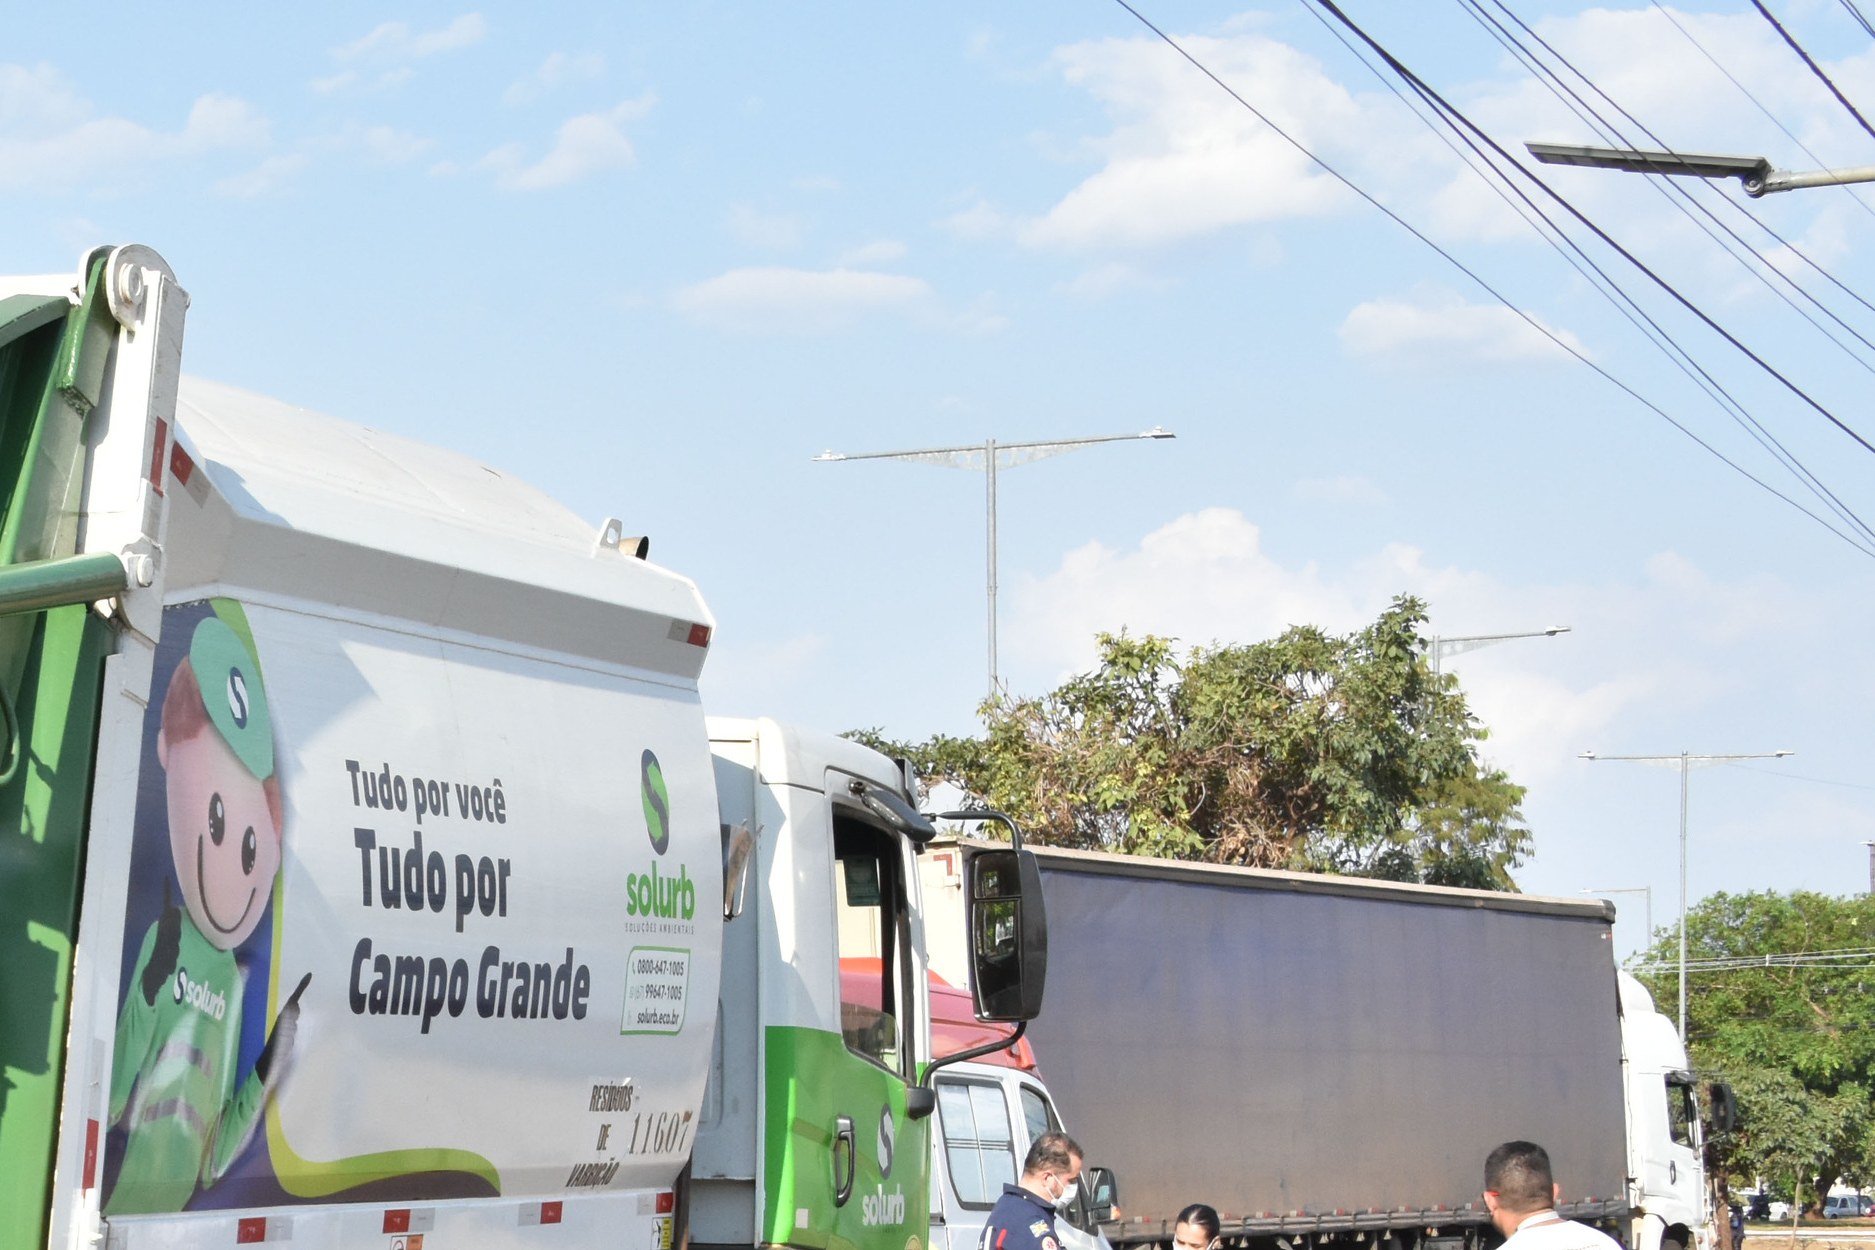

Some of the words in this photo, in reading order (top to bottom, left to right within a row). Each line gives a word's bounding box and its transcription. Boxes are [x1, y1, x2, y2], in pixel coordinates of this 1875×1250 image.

[345, 759, 408, 812] Tudo
[412, 777, 450, 825] por
[455, 778, 507, 825] você
[354, 827, 447, 913] Tudo
[455, 853, 511, 933] por
[626, 860, 696, 921] solurb
[185, 980, 226, 1020] solurb
[349, 937, 469, 1034] Campo
[476, 945, 591, 1021] Grande
[637, 1006, 680, 1026] solurb.eco.br
[596, 1123, 612, 1151] DE
[861, 1184, 906, 1227] solurb
